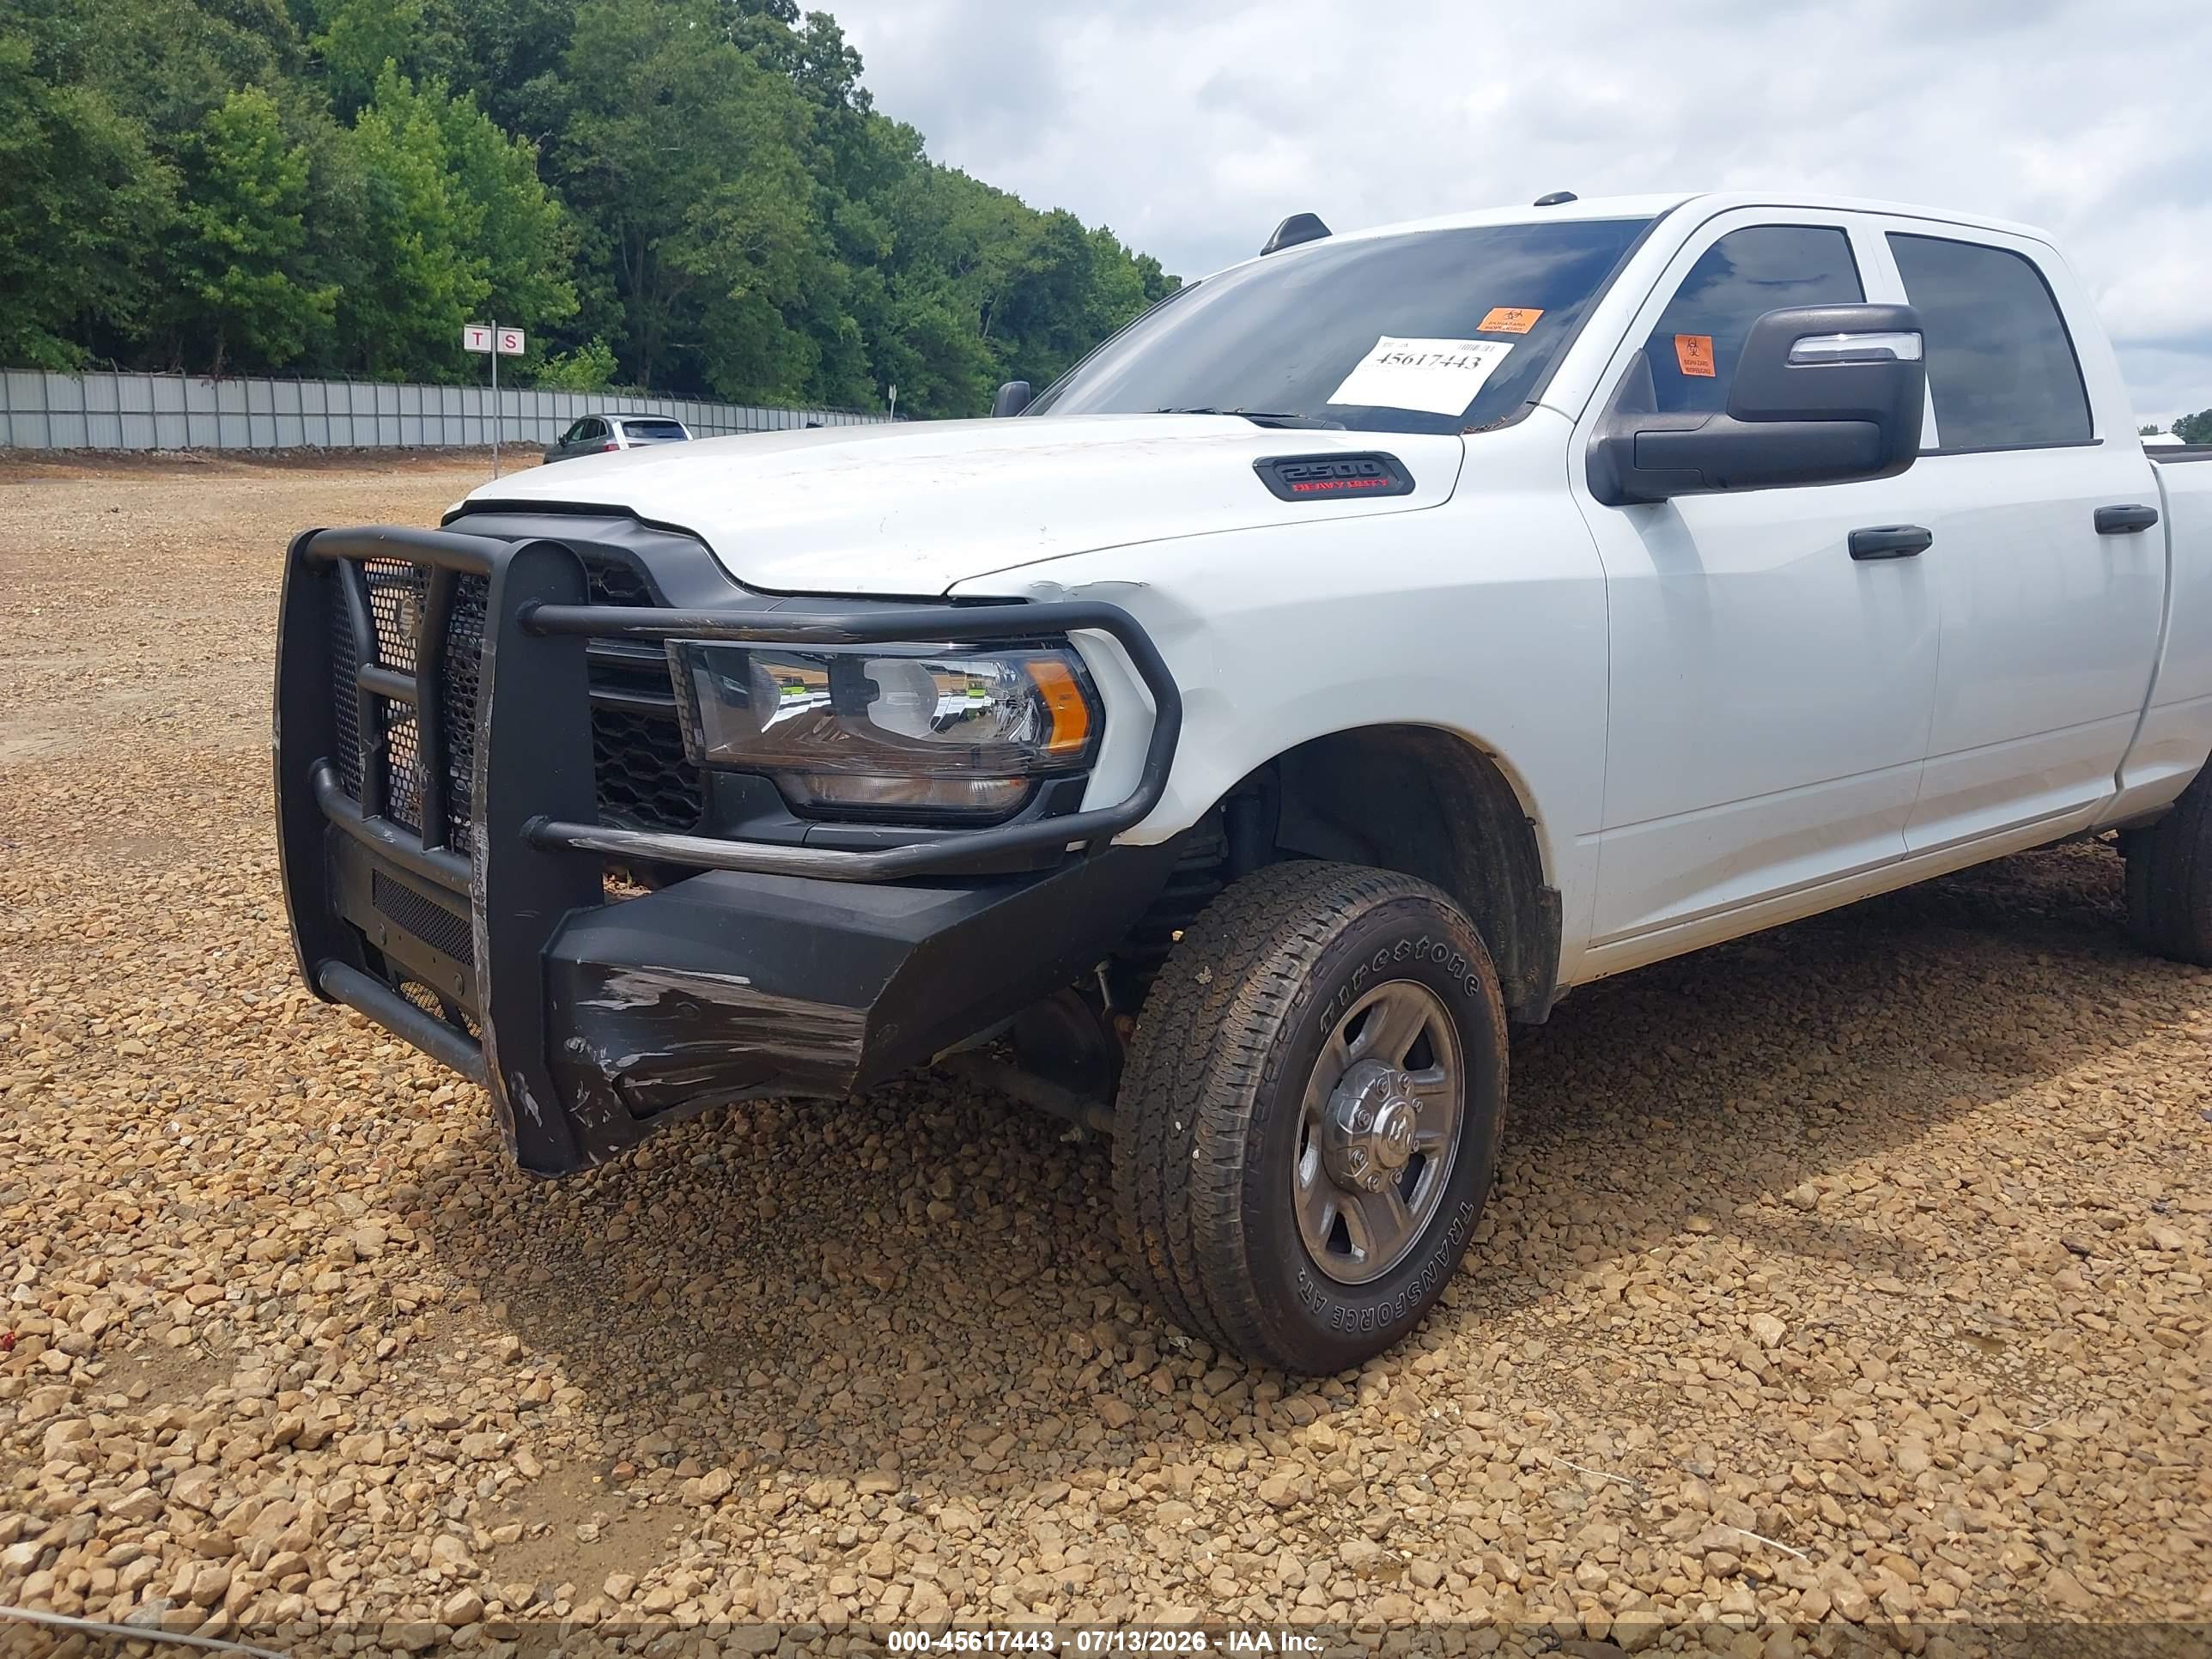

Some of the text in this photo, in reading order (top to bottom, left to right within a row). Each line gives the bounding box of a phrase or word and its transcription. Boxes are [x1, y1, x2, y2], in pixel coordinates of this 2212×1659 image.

[472, 331, 483, 346] T
[505, 335, 517, 349] S
[1376, 352, 1482, 370] 45617443
[1281, 459, 1382, 483] 2500
[1292, 477, 1389, 493] HEAVY DUTY
[1320, 934, 1480, 1036] Firestone
[1332, 1201, 1474, 1332] TRANSFORCE
